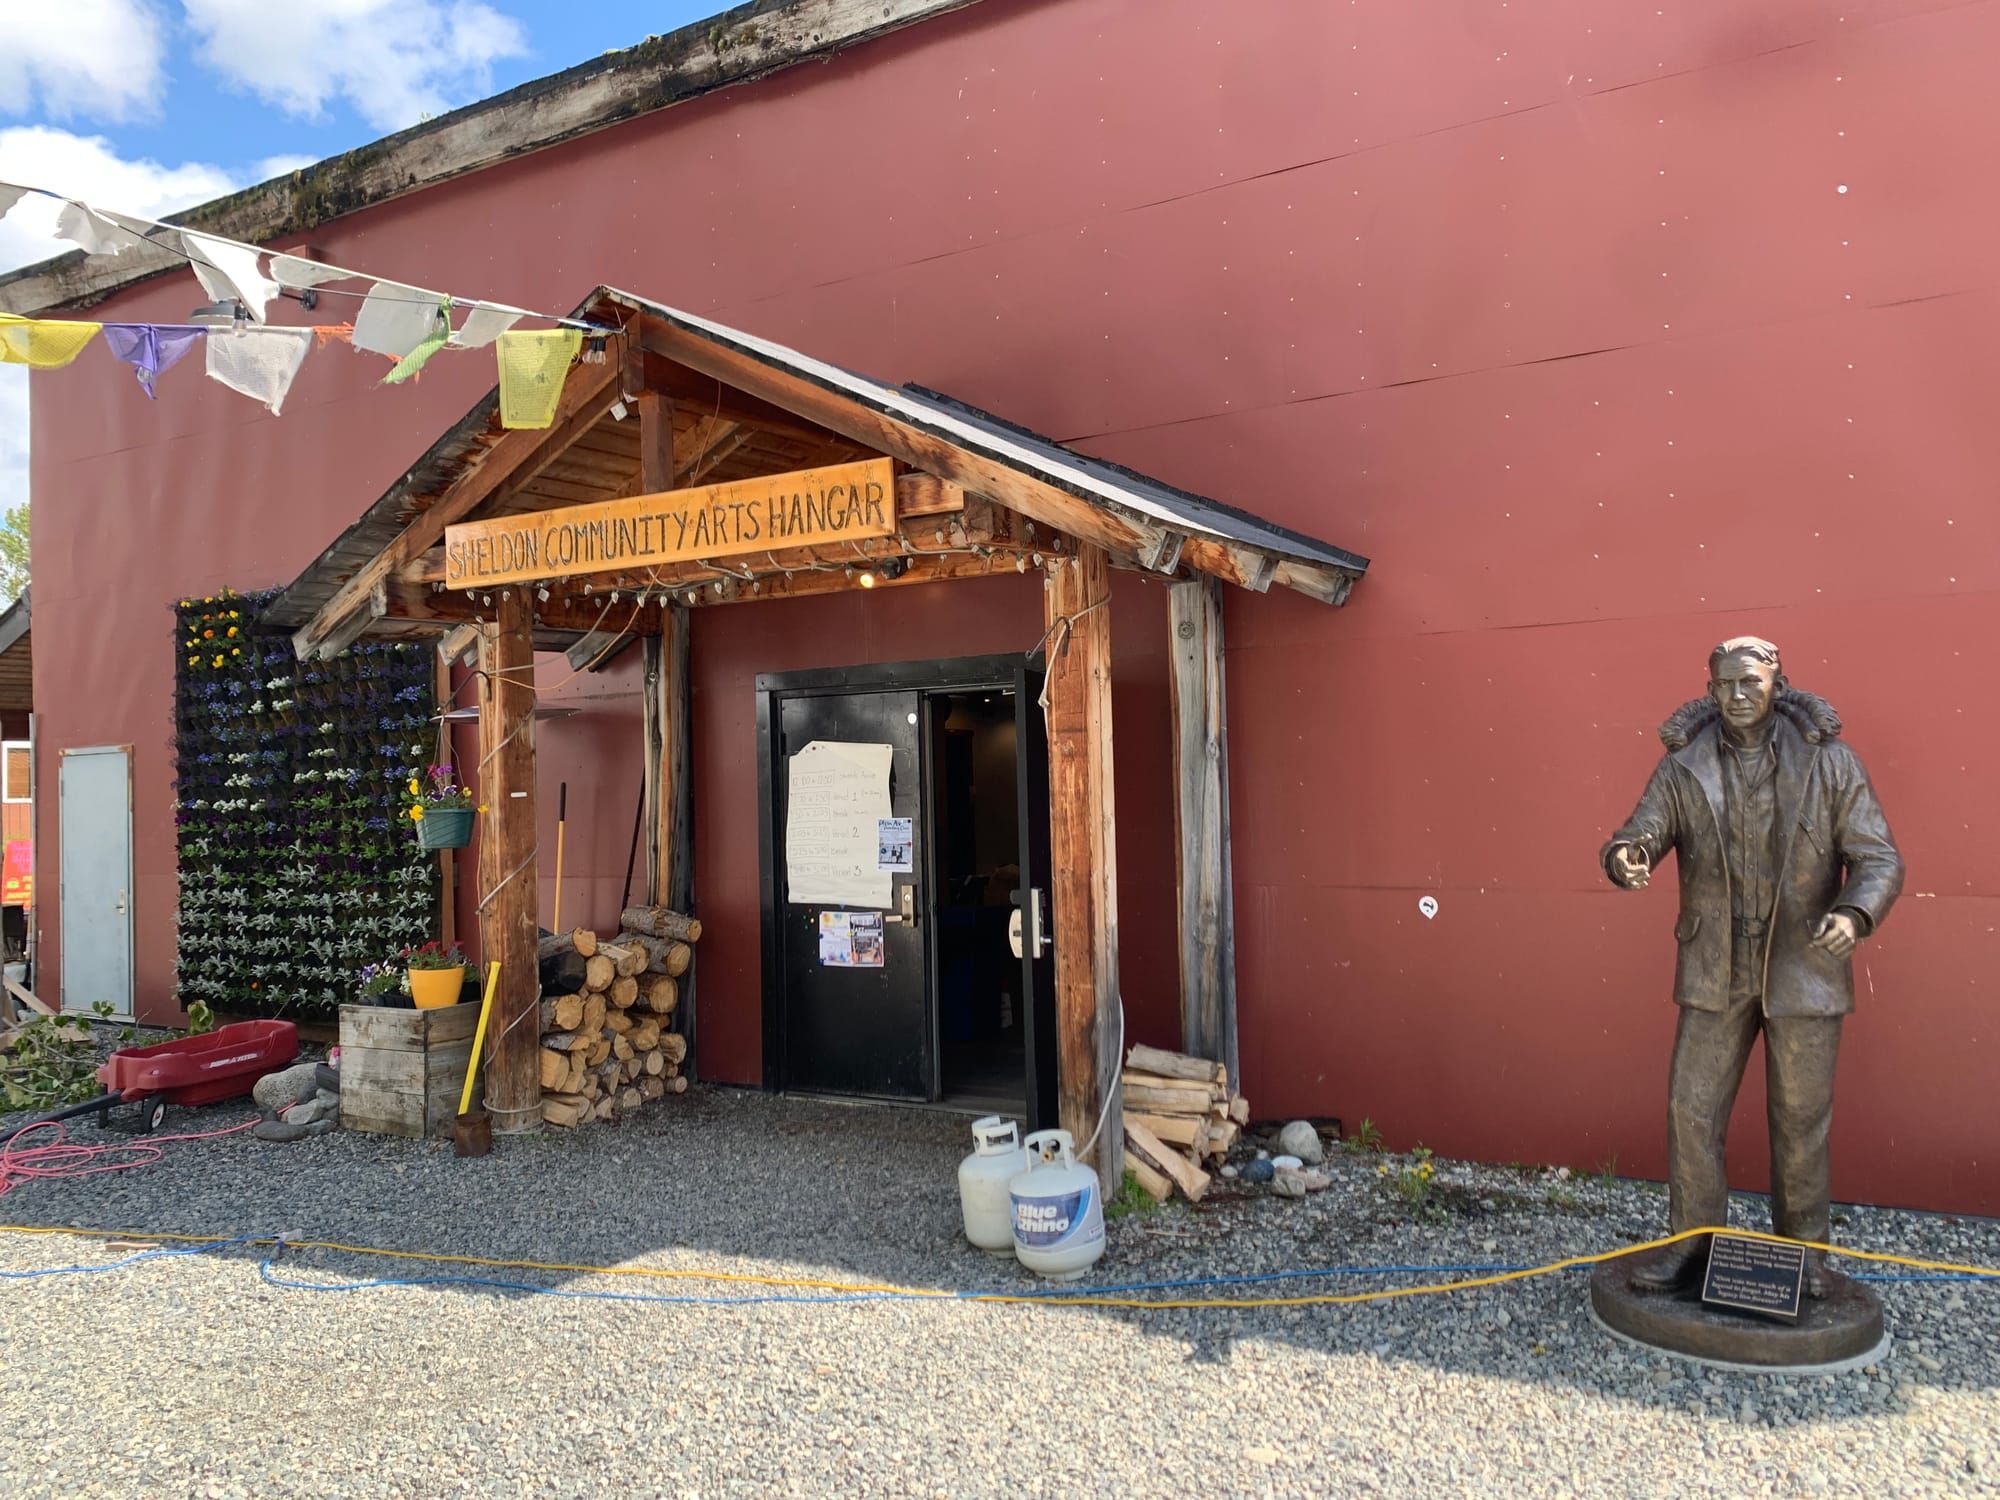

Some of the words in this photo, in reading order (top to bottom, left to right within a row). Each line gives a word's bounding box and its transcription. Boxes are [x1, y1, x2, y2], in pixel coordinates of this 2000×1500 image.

[449, 527, 538, 580] SHELDON
[545, 510, 688, 567] COMMUNITY
[693, 500, 761, 548] ARTS
[767, 481, 885, 538] HANGAR
[1017, 1203, 1057, 1220] Blue
